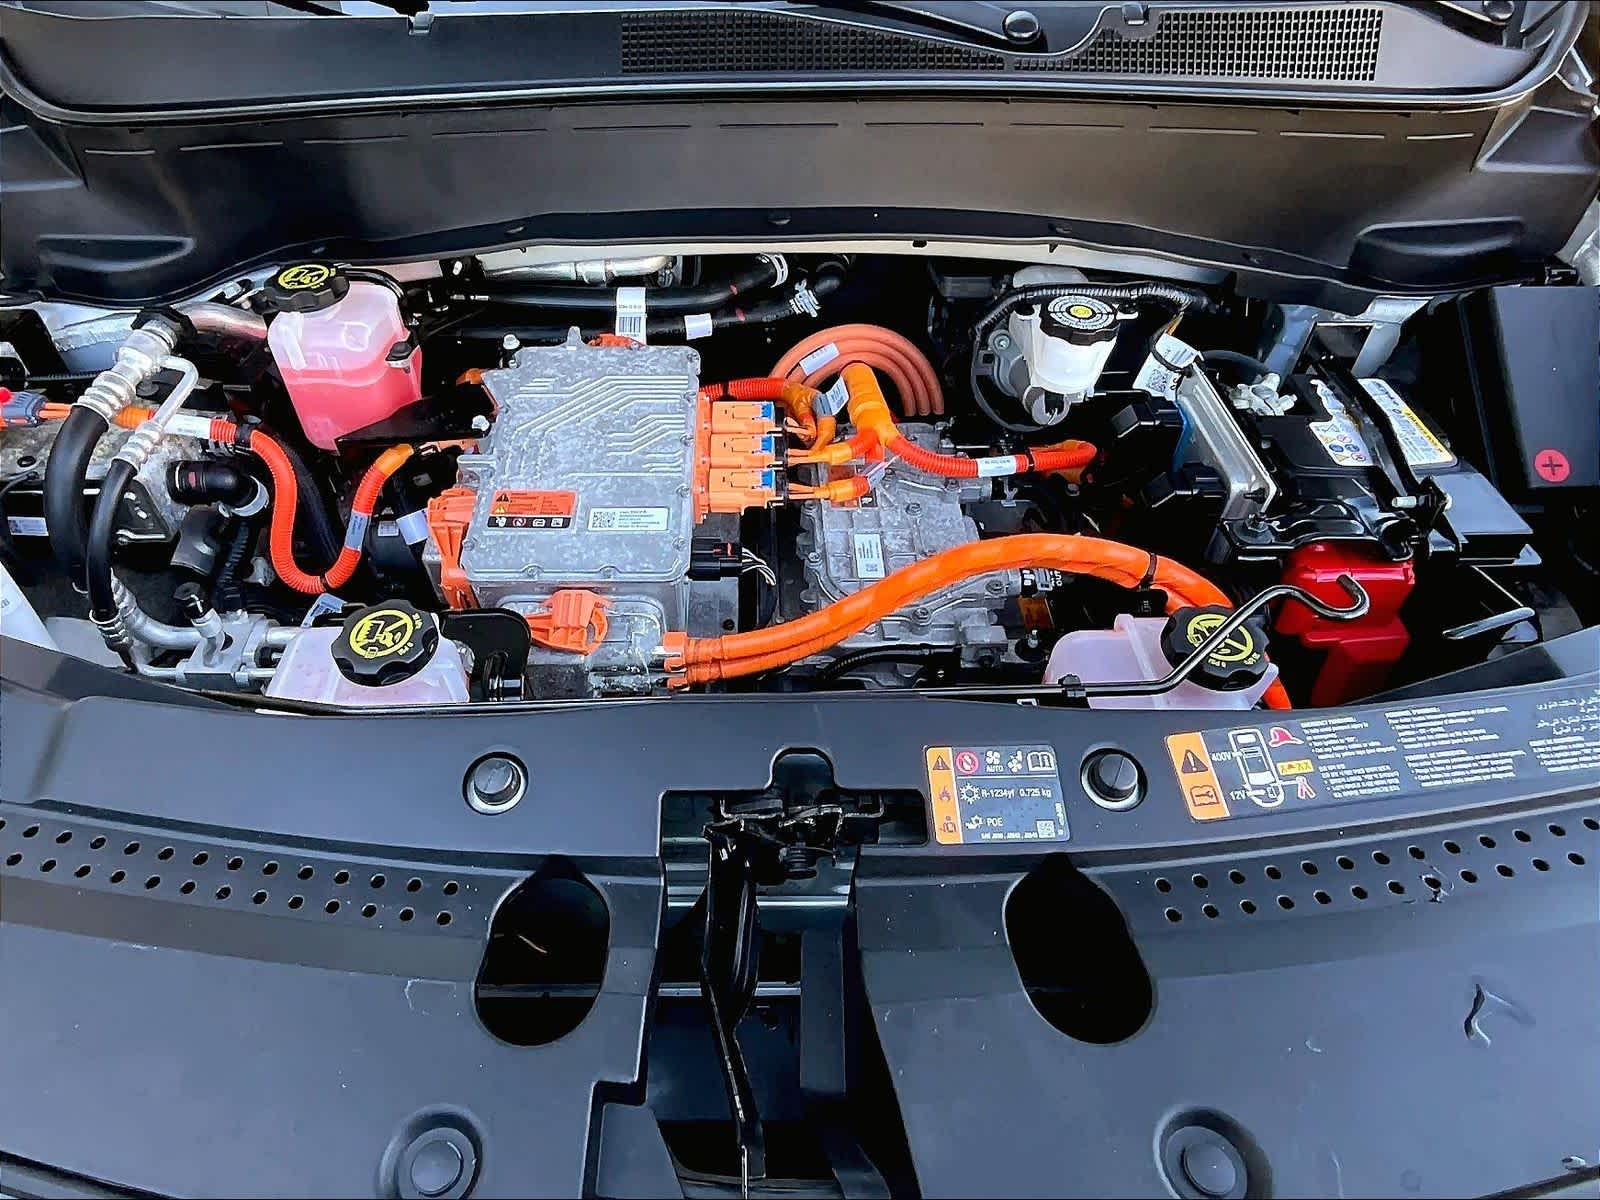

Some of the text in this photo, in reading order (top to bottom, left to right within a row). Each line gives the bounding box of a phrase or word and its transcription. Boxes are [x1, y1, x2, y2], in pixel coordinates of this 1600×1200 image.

[1211, 752, 1232, 762] 400V
[1229, 790, 1246, 801] 12V
[986, 817, 1003, 827] POE
